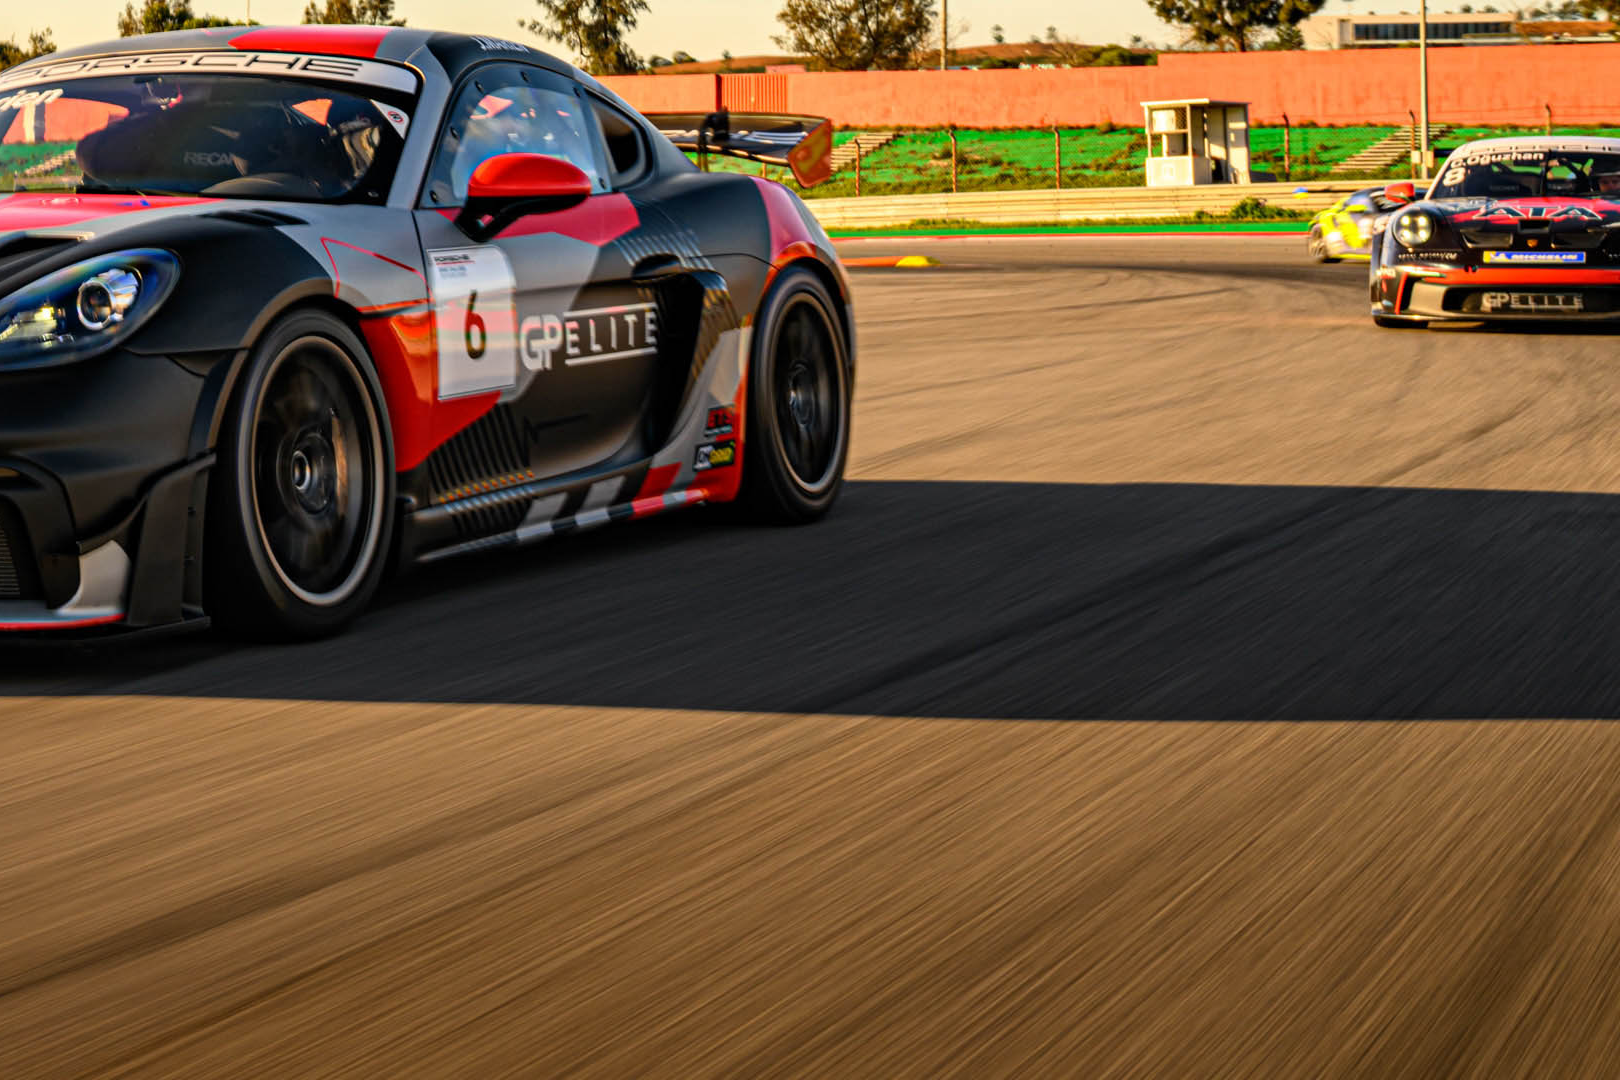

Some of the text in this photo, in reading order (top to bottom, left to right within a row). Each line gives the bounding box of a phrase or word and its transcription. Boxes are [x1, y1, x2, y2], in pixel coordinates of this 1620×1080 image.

[1443, 167, 1466, 187] 8
[1472, 206, 1602, 220] ATA
[464, 290, 487, 360] 6
